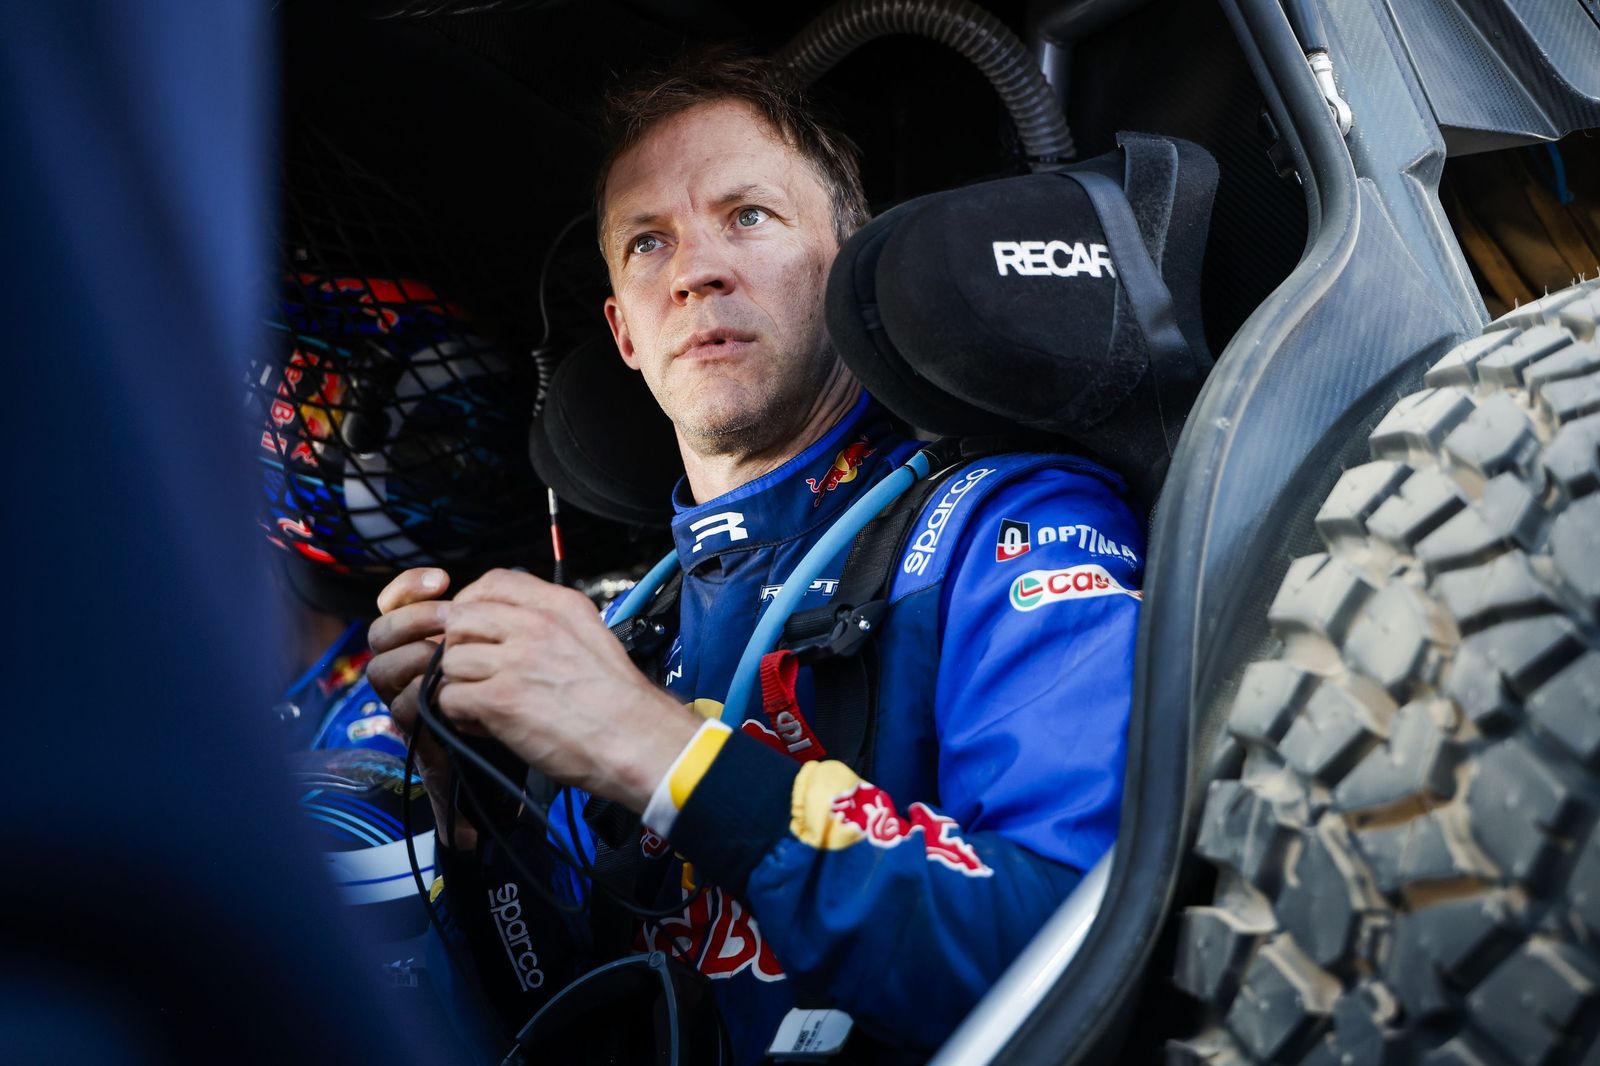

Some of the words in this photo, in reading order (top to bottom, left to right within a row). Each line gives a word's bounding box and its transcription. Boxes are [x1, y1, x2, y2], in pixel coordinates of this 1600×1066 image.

[992, 239, 1117, 279] RECAR
[903, 468, 996, 576] sparco
[1037, 524, 1138, 563] OPTIMA
[487, 882, 545, 992] sparco
